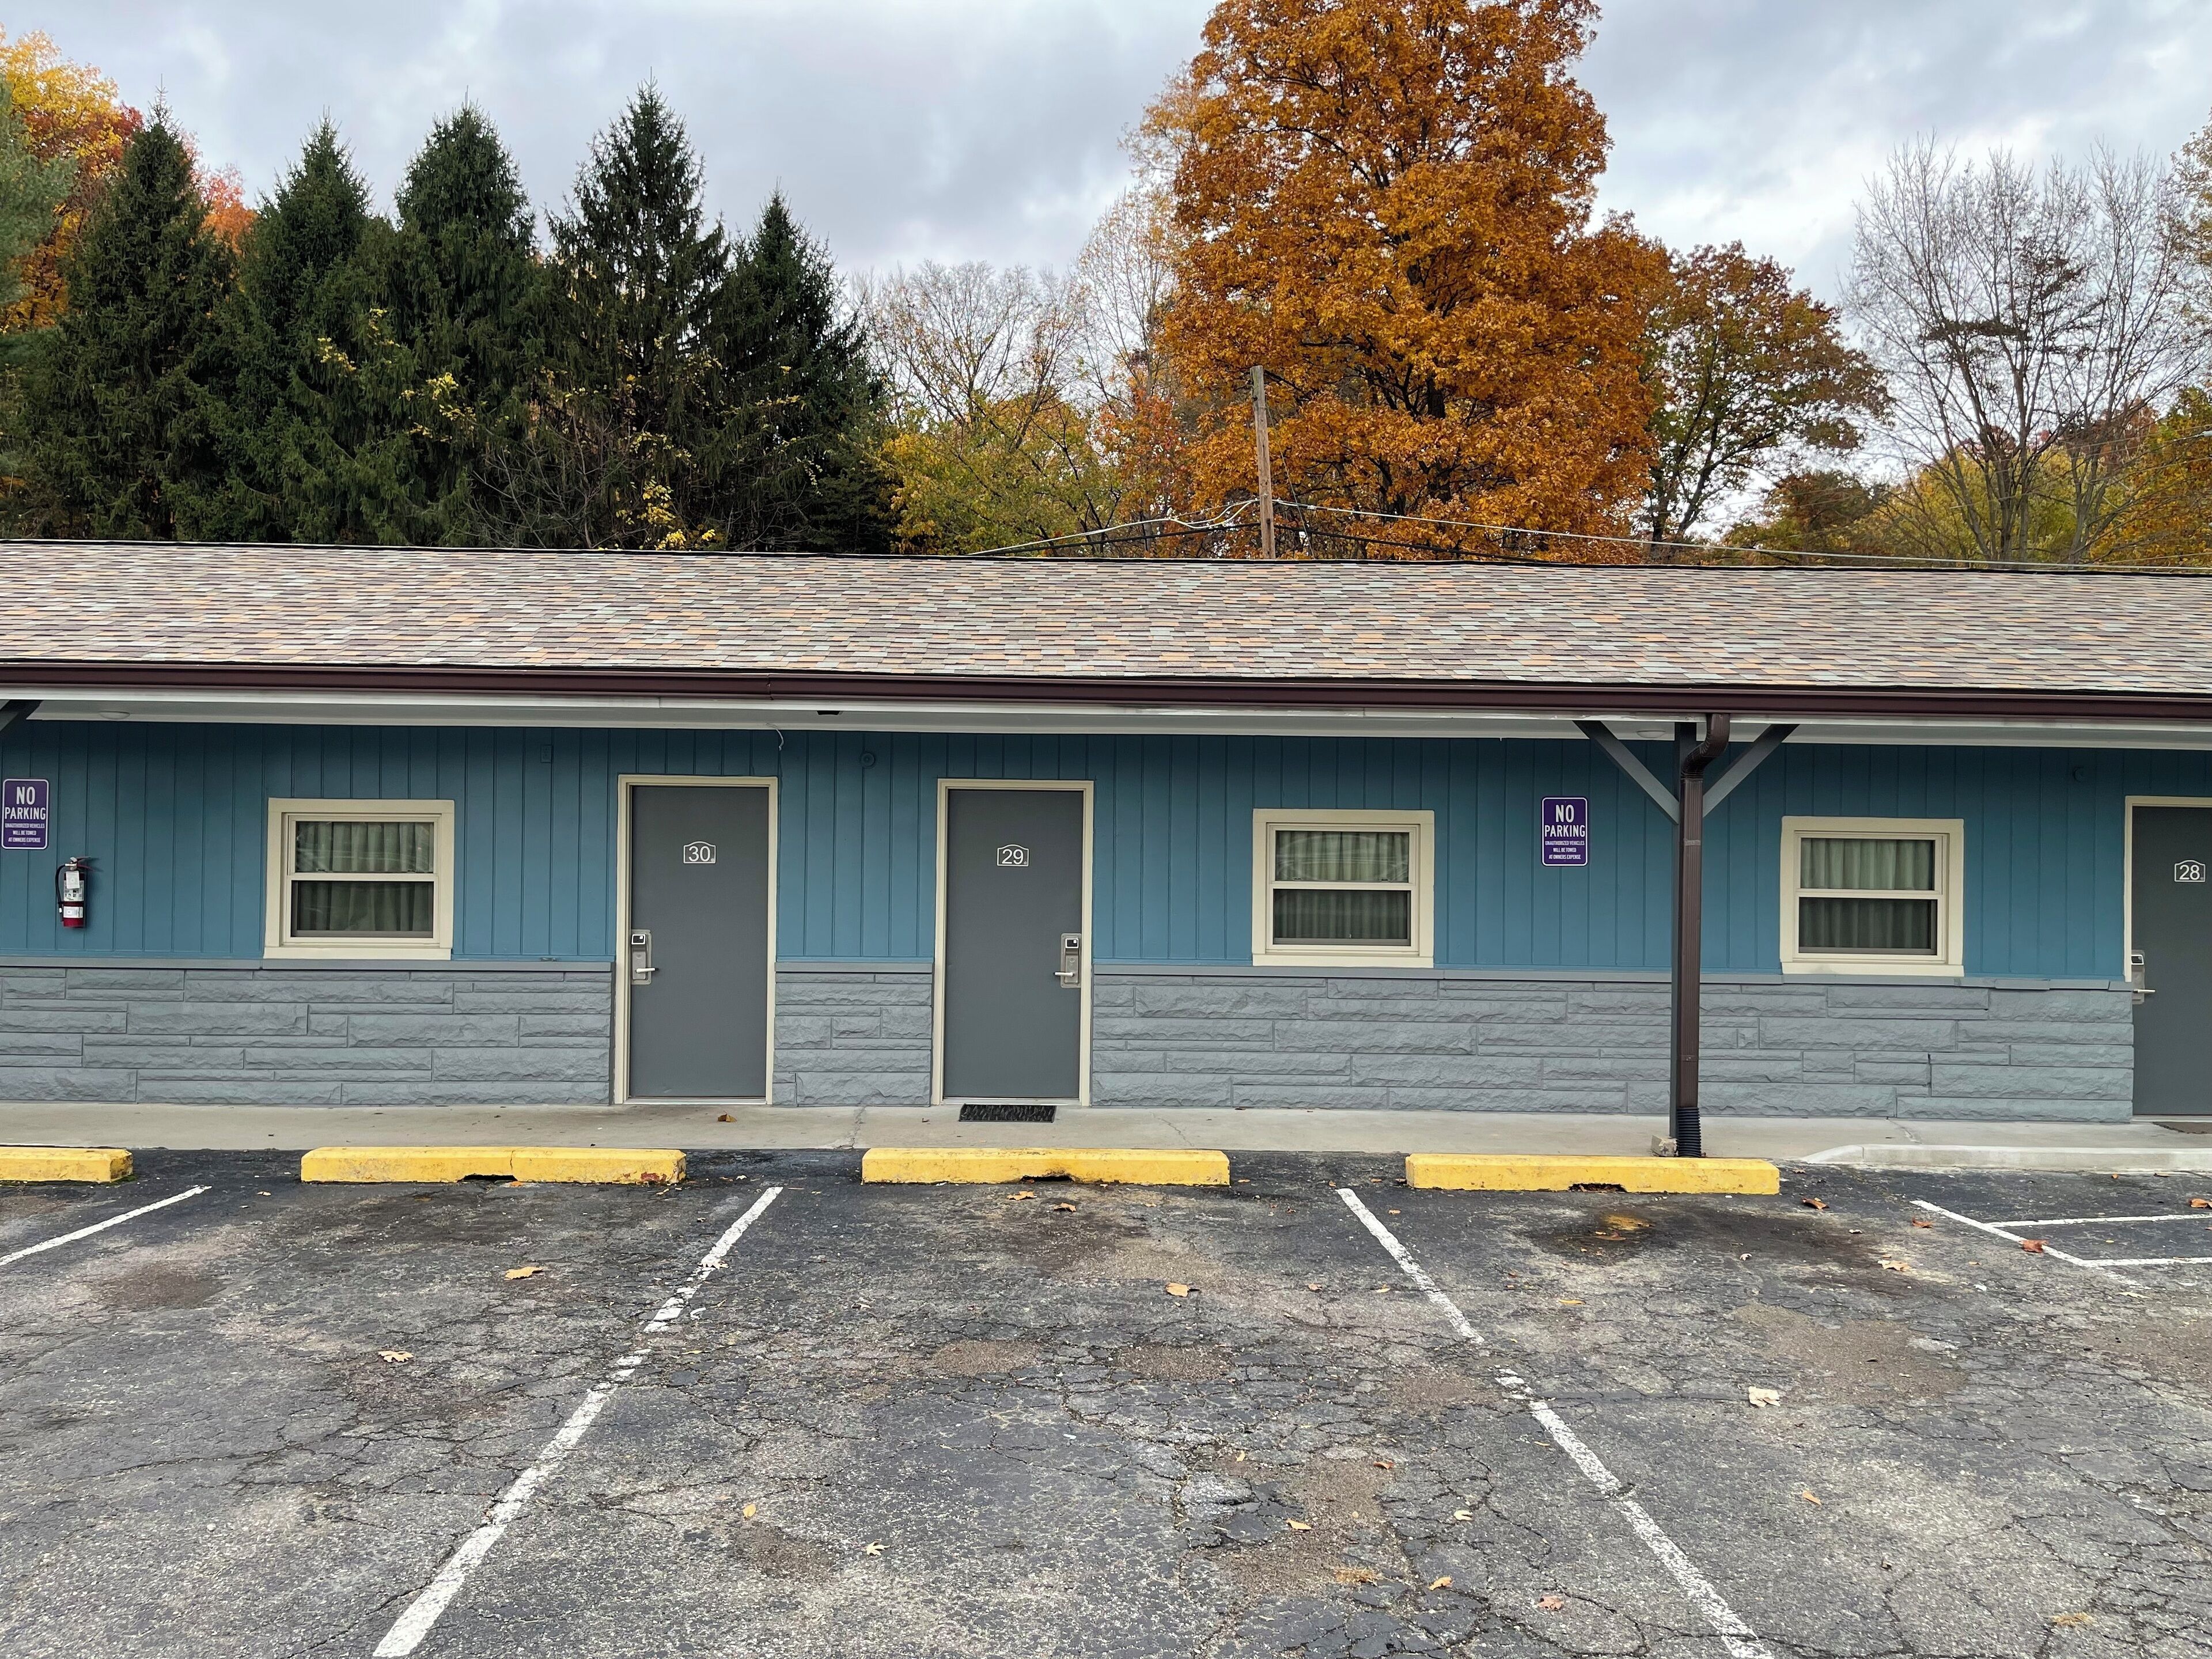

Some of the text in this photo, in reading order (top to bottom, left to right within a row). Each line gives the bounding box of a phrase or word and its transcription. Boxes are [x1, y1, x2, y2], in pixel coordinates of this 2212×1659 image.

[16, 786, 35, 805] NO
[5, 807, 46, 820] PARKING
[1555, 804, 1574, 823] NO
[1544, 825, 1585, 837] PARKING
[688, 846, 711, 862] 30
[1002, 849, 1024, 865] 29
[2179, 864, 2200, 880] 28
